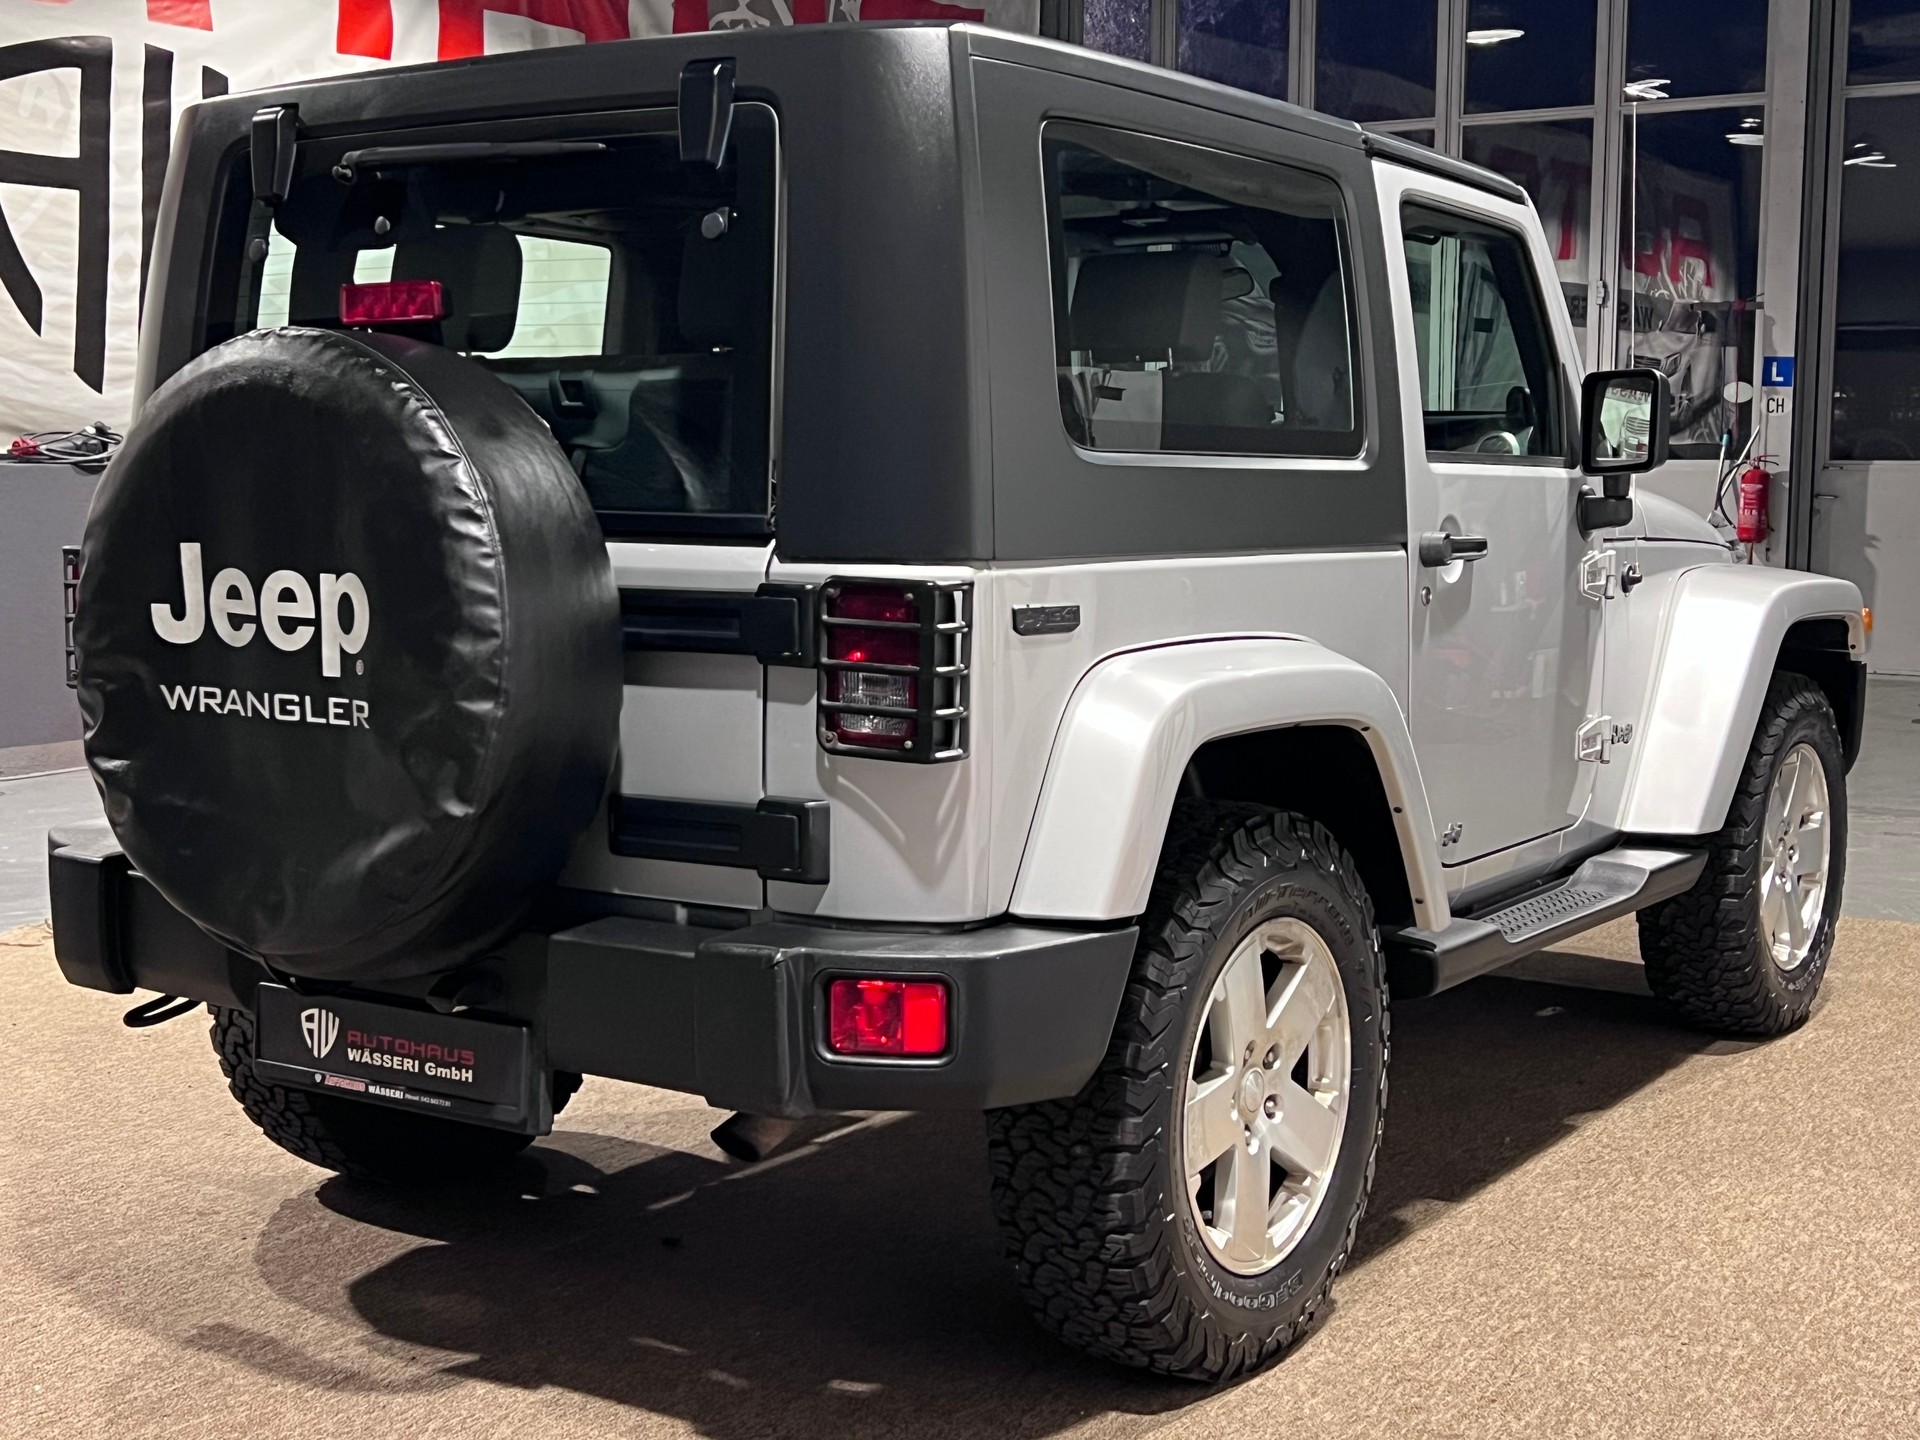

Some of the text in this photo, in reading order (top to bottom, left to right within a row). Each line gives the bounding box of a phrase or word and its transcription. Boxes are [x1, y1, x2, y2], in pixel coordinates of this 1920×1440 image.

[1771, 361, 1784, 382] L
[1766, 397, 1785, 414] CH
[151, 542, 370, 678] Jeep
[159, 684, 370, 729] WRANGLER
[347, 1030, 475, 1066] AUTOHAUS
[347, 1047, 473, 1083] WÄSSERI GmbH
